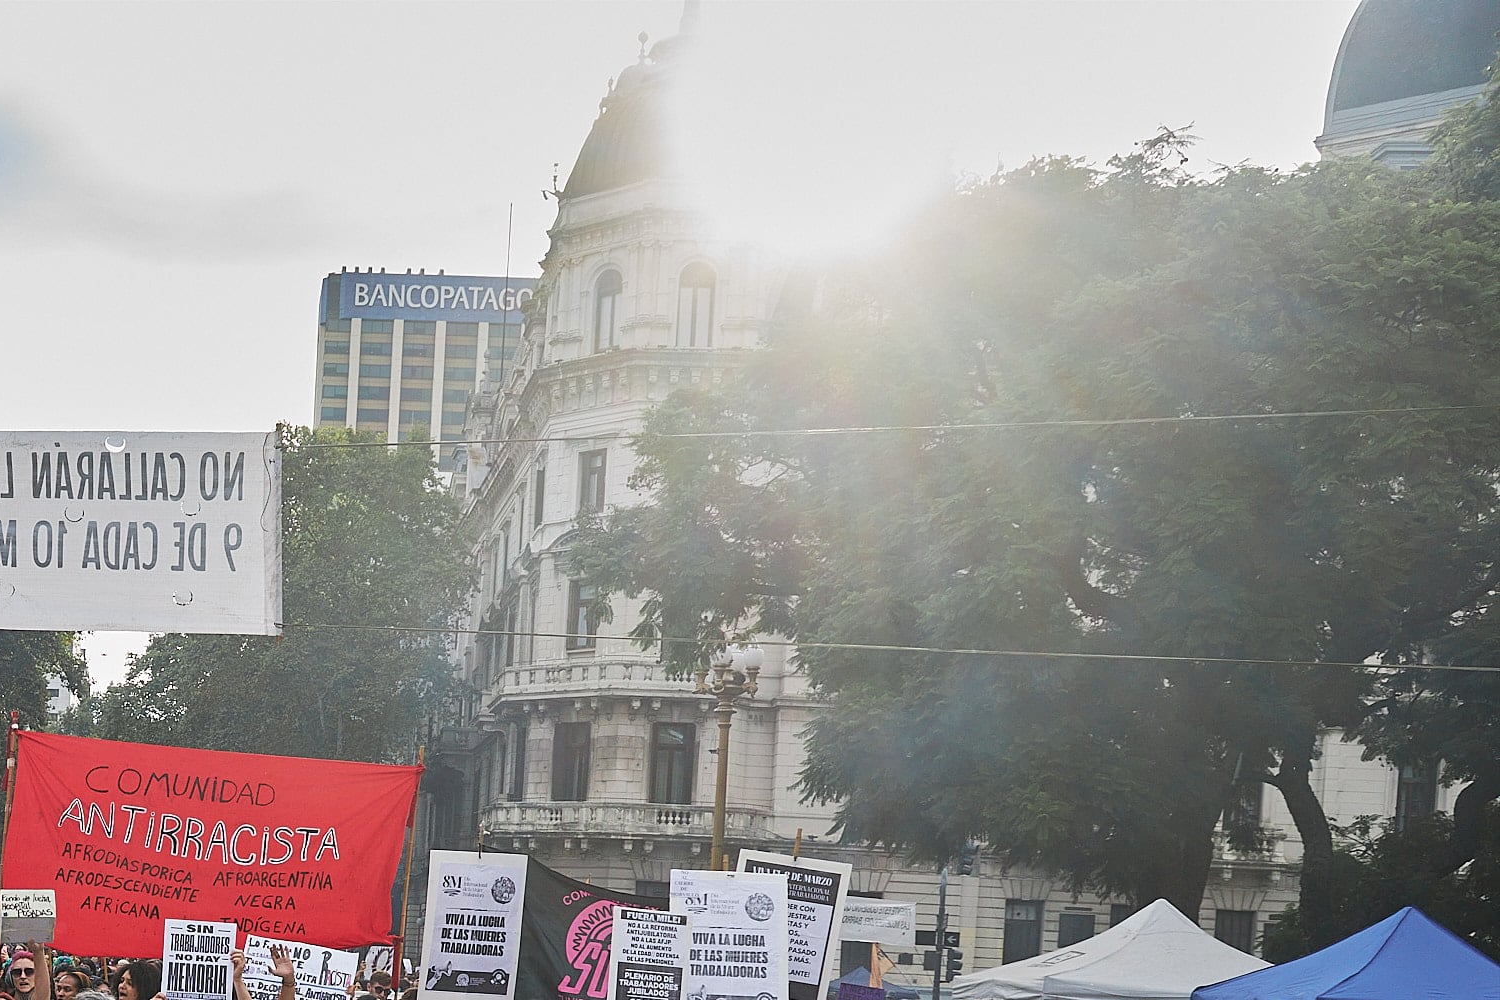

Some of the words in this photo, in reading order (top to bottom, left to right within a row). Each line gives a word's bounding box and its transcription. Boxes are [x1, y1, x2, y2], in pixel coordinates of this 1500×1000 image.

[85, 766, 276, 807] COMUNIDAD
[791, 872, 804, 882] DE
[804, 875, 833, 887] MARZO
[234, 894, 296, 911] NEGRA
[799, 905, 816, 913] CON
[17, 908, 54, 919] POSADAS
[626, 911, 655, 922] FUERA
[656, 913, 681, 924] MILEI
[445, 913, 465, 926] VIVA
[467, 914, 477, 927] LA
[478, 915, 506, 928] LUCHA
[186, 923, 214, 934] SIN
[441, 927, 453, 939] DE
[453, 928, 470, 941] LAS
[471, 929, 507, 943] MUJERES
[650, 924, 678, 933] REFORMA
[170, 933, 230, 954] TRABAJADORES
[692, 932, 716, 946] VIVA
[718, 933, 731, 946] LA
[733, 934, 766, 948] LUCHA
[790, 938, 809, 947] PARA
[440, 941, 505, 957] TRABAJADORAS
[646, 944, 672, 952] AUMENTO
[788, 946, 817, 957] PASADO
[175, 953, 193, 961] NO
[195, 954, 221, 963] HAY
[645, 957, 674, 966] PENSIONES
[690, 949, 703, 962] DE
[704, 949, 723, 963] LAS
[725, 950, 769, 964] MUJERES
[167, 961, 228, 994] MEMORIA
[624, 971, 662, 982] PLENARIO
[689, 963, 768, 979] TRABAJADORAS
[619, 978, 678, 991] TRABAJADORES
[627, 987, 670, 998] JUBILADOS
